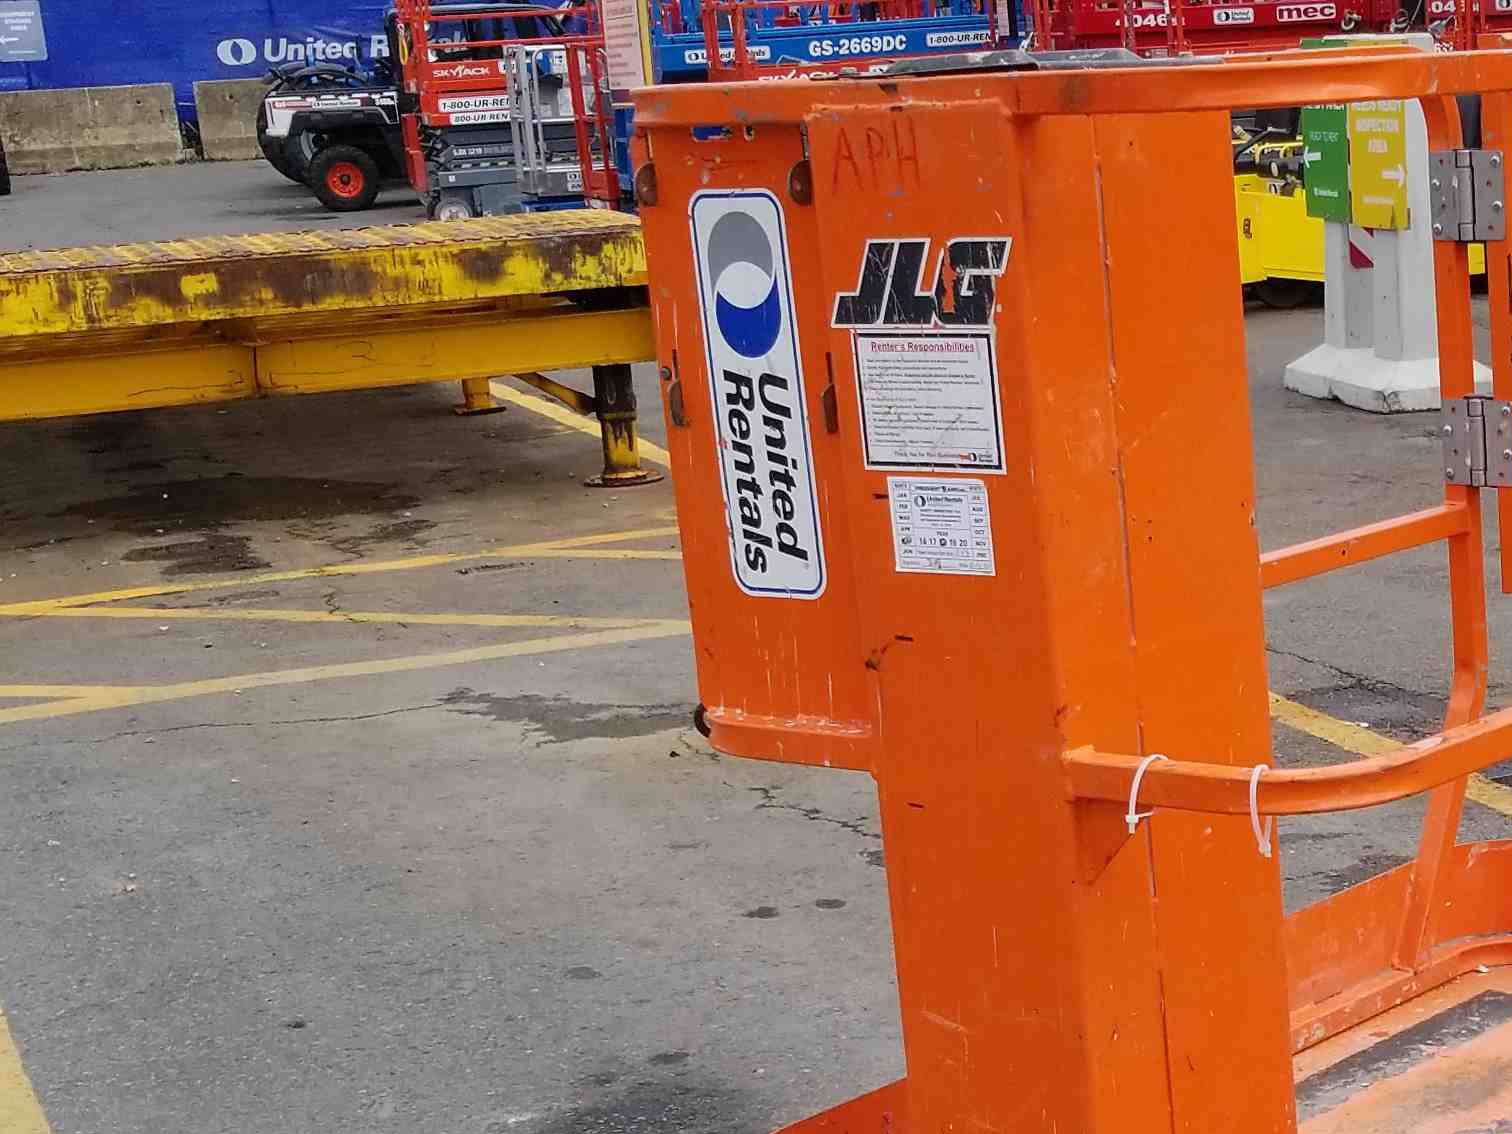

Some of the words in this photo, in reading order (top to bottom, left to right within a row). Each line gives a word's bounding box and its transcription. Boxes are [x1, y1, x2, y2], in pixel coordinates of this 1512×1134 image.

[1278, 4, 1336, 19] mec
[808, 35, 906, 57] GS-2669DC
[432, 65, 490, 78] SKYJACK
[832, 237, 1012, 328] JLG
[907, 342, 975, 353] Responsibilities
[722, 369, 773, 574] Rentals
[758, 371, 809, 563] United
